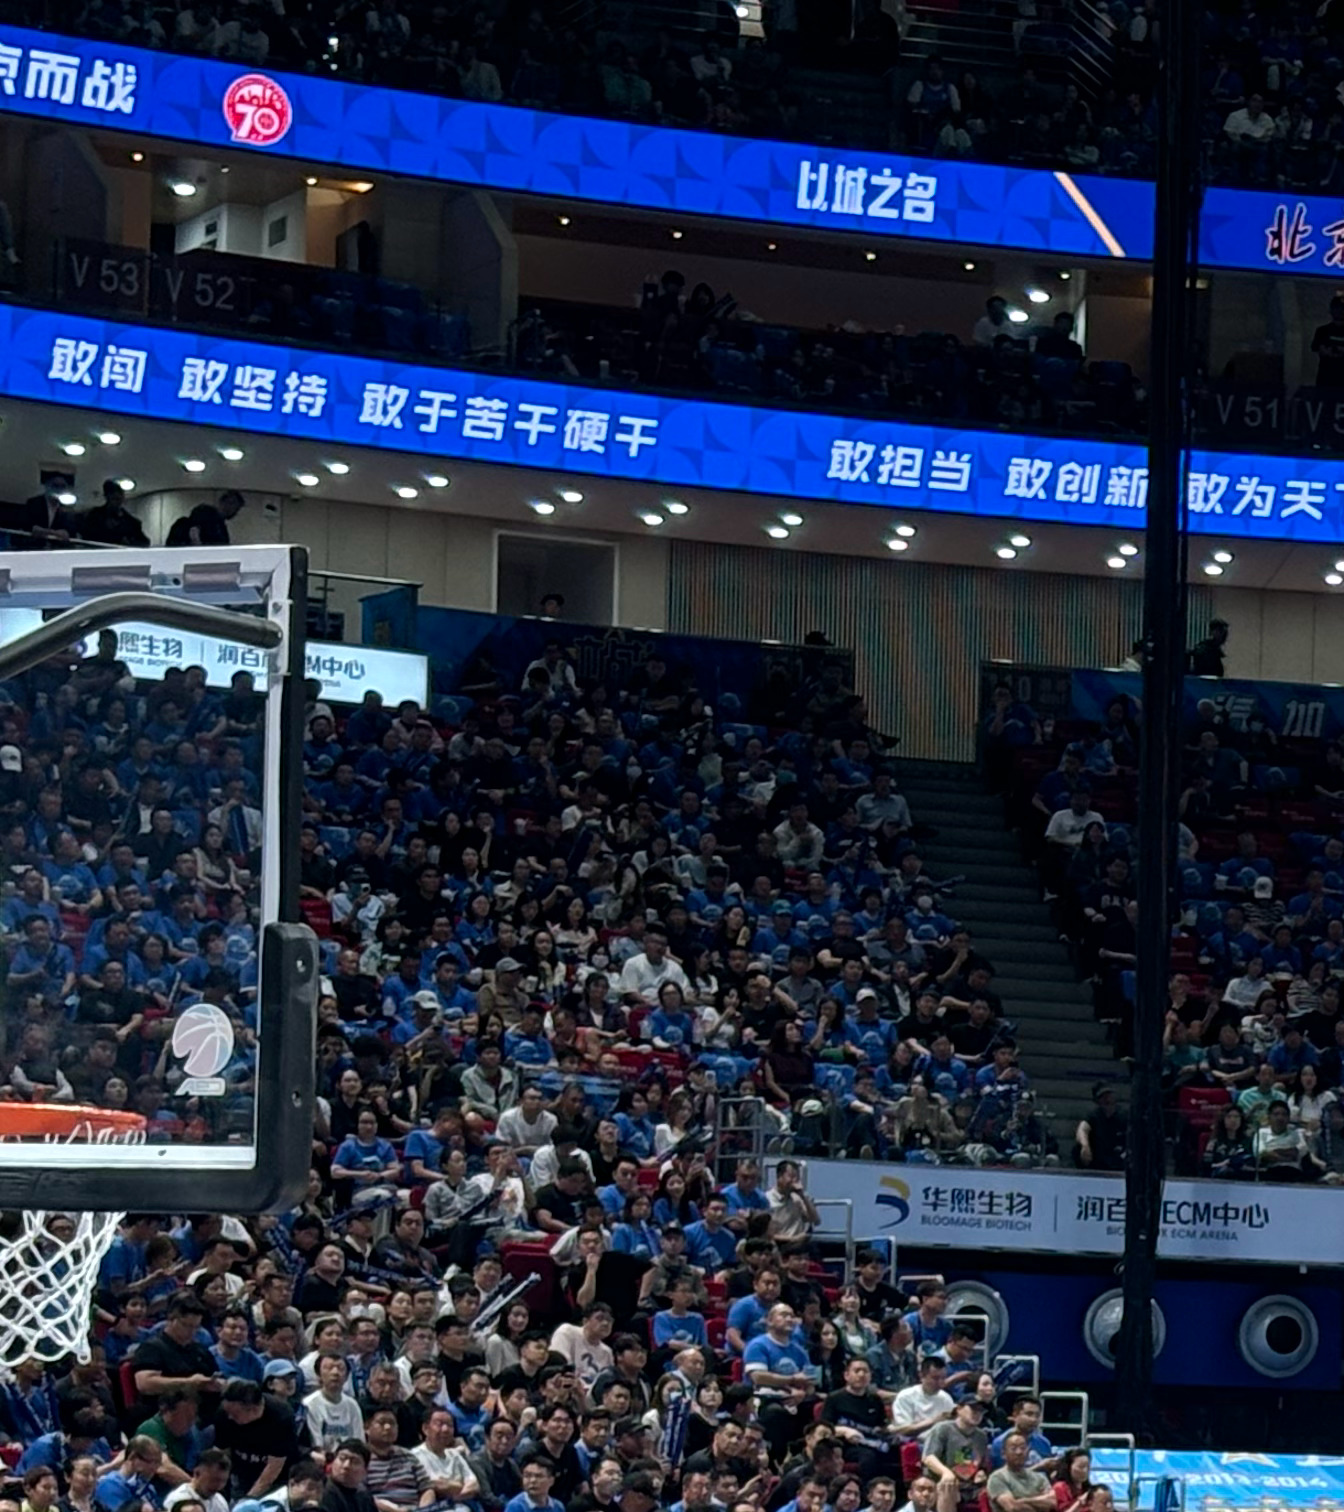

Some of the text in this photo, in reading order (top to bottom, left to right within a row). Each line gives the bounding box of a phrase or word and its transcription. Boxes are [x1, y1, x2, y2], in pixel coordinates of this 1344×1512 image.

[797, 161, 938, 222] 以城之名
[100, 258, 139, 297] 53
[195, 274, 236, 312] 52
[49, 337, 658, 458] 敢闯 敢坚持 敢于苦干硬干
[1244, 399, 1279, 430] 51
[828, 440, 971, 492] 敢担当
[1005, 457, 1149, 510] 敢创新
[921, 1186, 1032, 1218] 华熙生物
[1076, 1195, 1269, 1229] 润百ECM中心
[921, 1216, 1031, 1232] BLOOMAGE BIOTECH
[1200, 1230, 1238, 1242] ARENA
